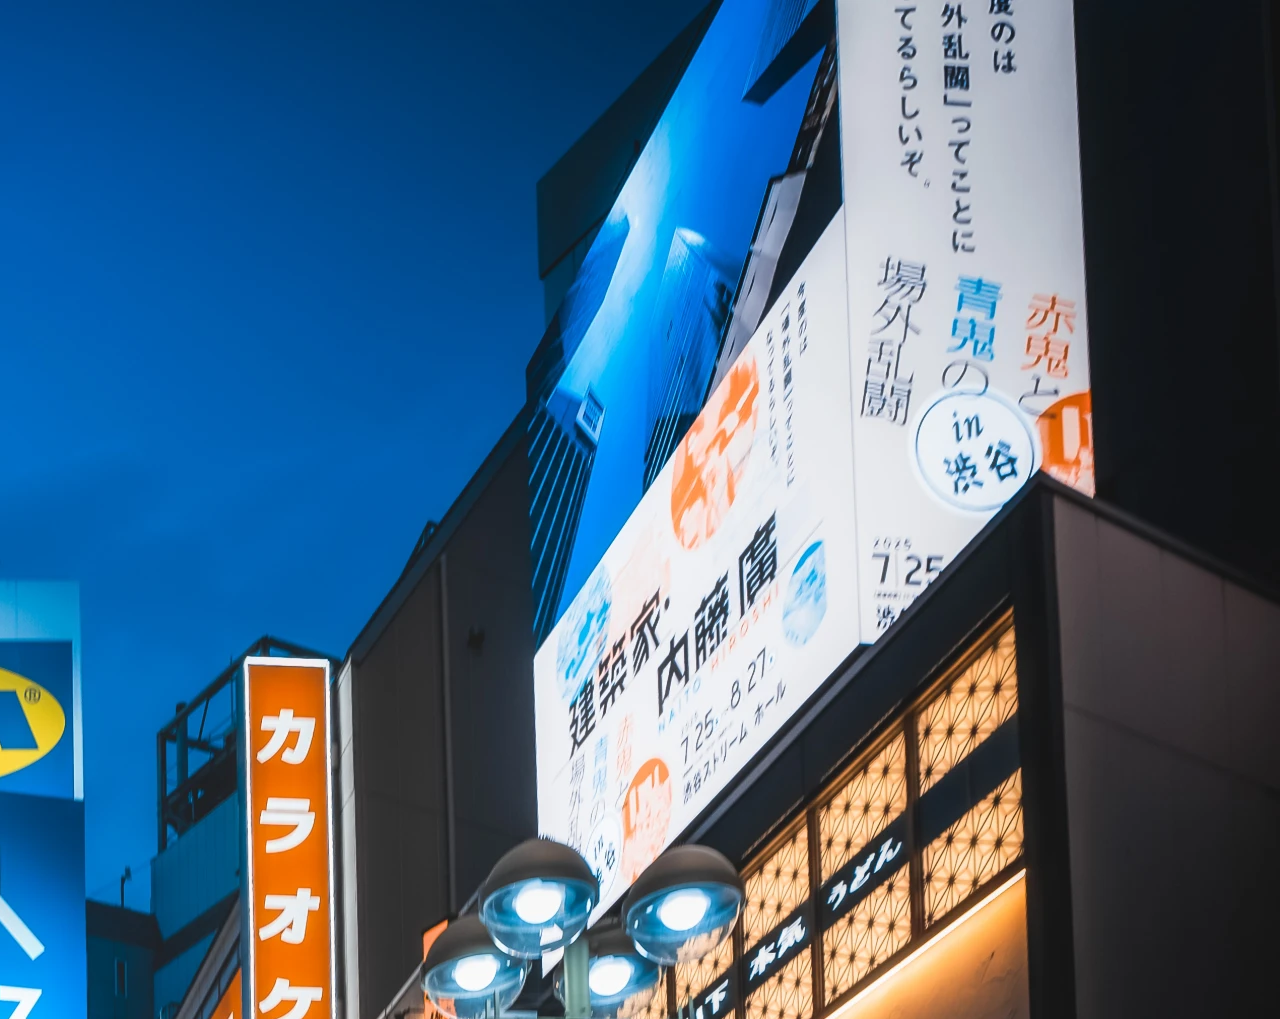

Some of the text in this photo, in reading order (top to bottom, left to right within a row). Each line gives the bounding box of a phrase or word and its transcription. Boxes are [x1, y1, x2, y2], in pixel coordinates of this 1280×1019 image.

[859, 254, 928, 427] 場外乱闘
[951, 410, 984, 444] in
[942, 439, 1020, 496] 渋谷
